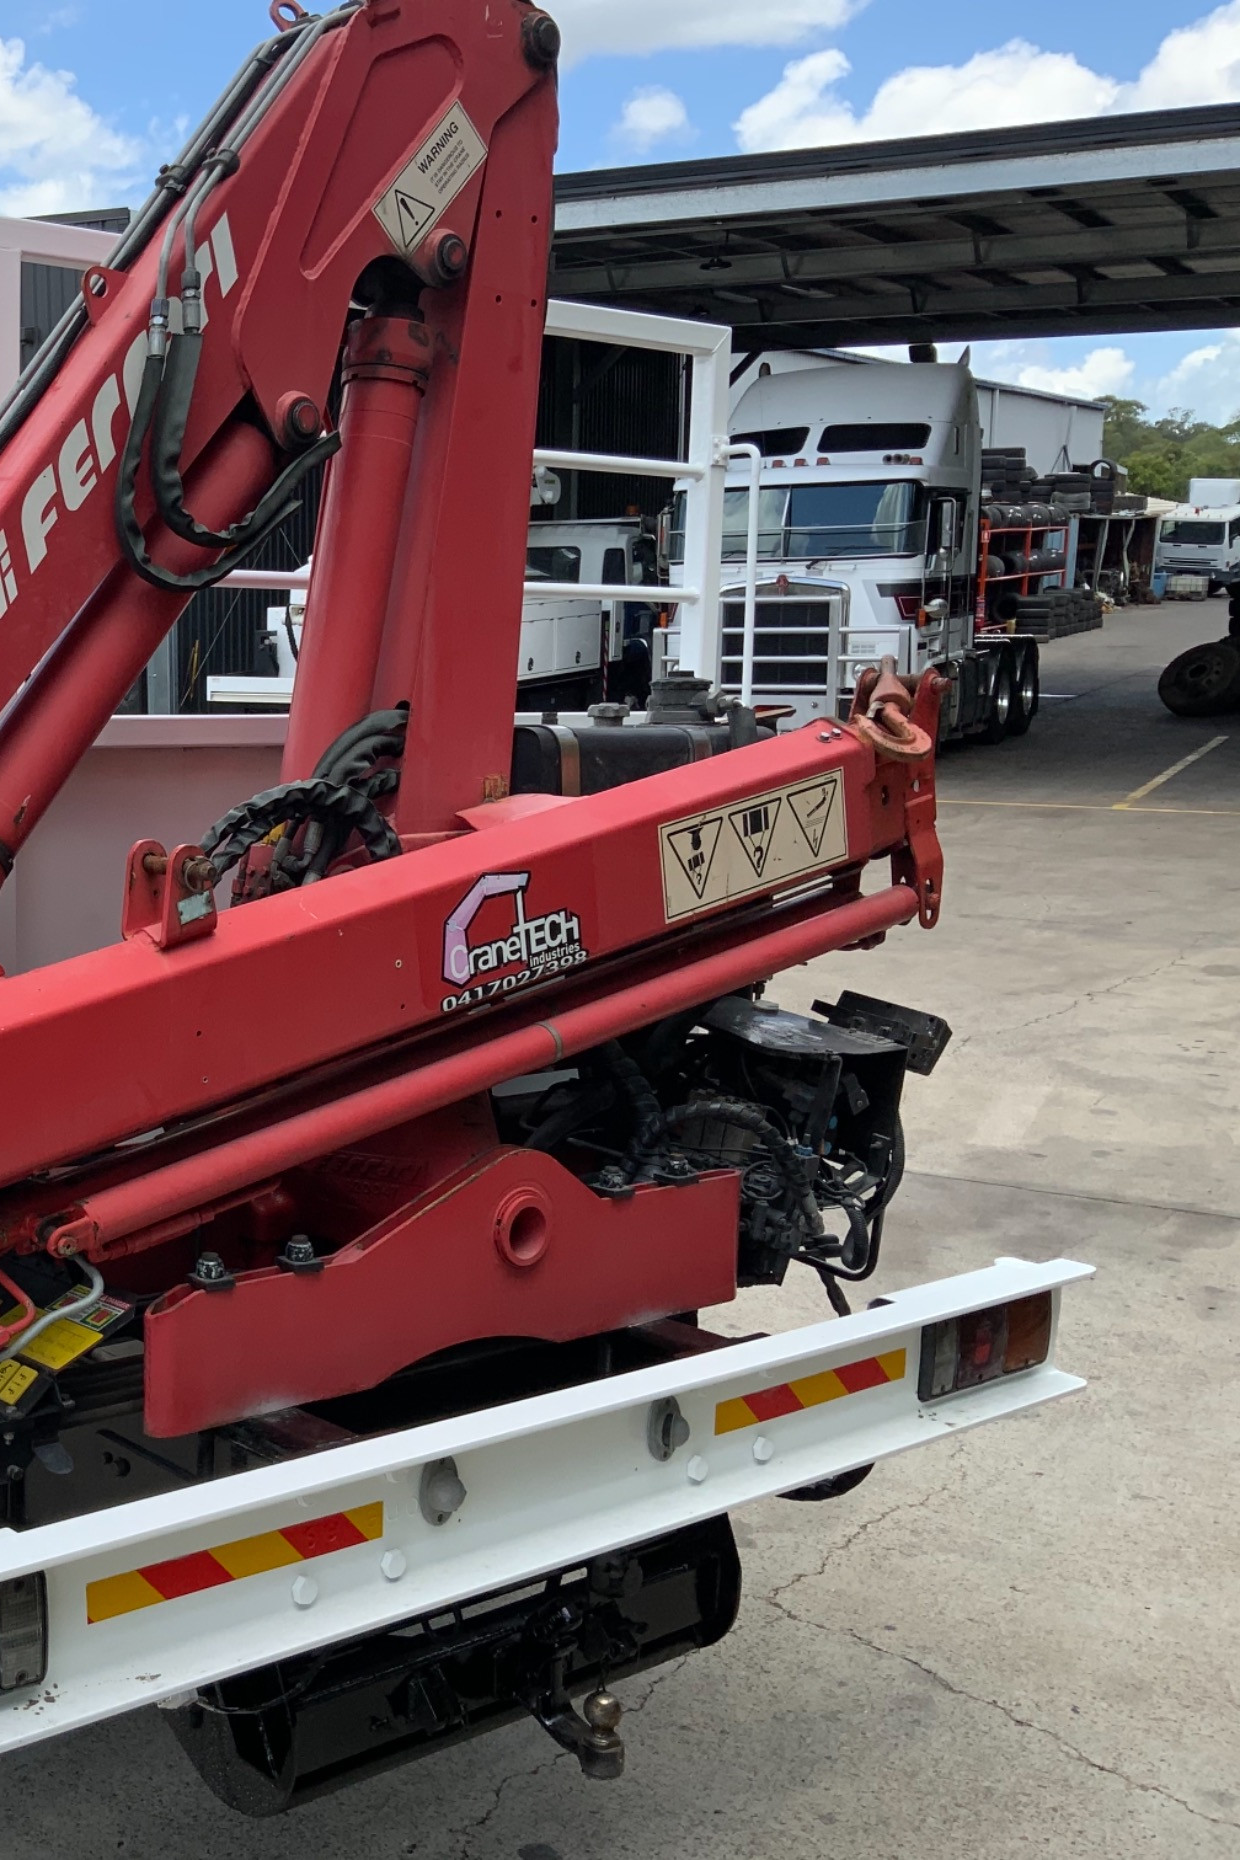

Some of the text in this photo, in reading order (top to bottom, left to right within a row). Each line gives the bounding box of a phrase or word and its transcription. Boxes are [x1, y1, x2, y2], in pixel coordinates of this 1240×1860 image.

[417, 121, 459, 174] WARNING
[442, 950, 588, 1012] 0417027398
[529, 942, 580, 968] industries
